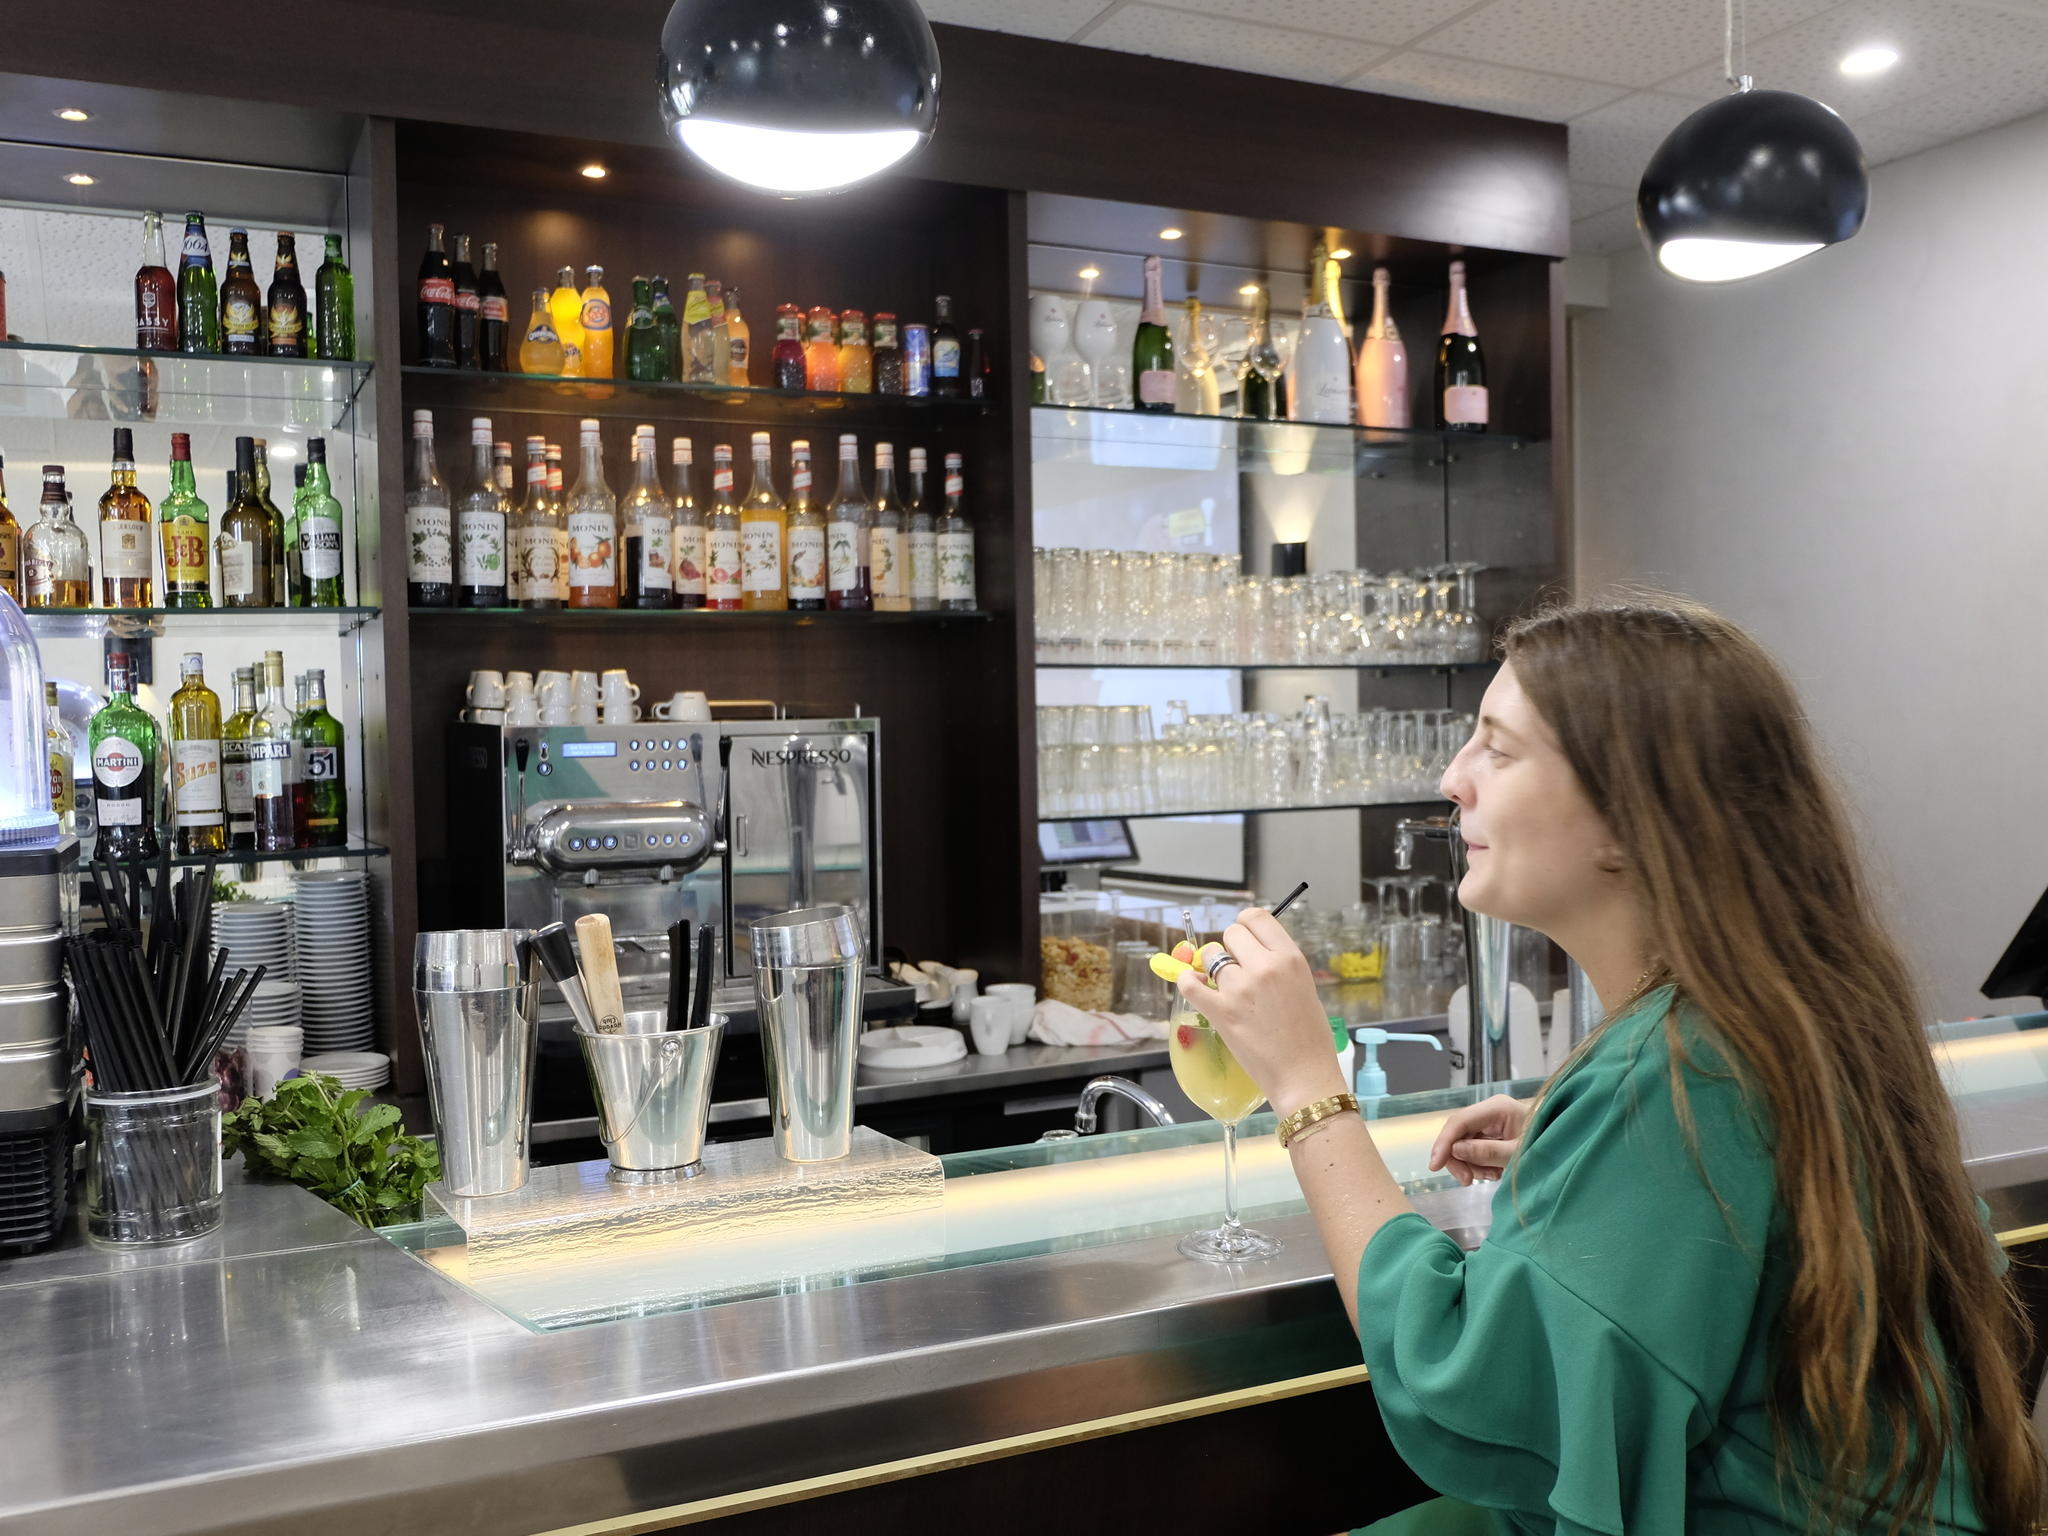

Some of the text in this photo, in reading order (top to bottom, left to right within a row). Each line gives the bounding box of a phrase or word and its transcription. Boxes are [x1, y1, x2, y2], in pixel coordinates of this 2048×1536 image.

[573, 524, 609, 532] MONIN
[302, 533, 337, 541] WILLIAM
[97, 757, 138, 767] MARTINI
[308, 752, 335, 776] 51
[750, 748, 852, 768] NESPRESSO
[175, 761, 217, 789] Suze
